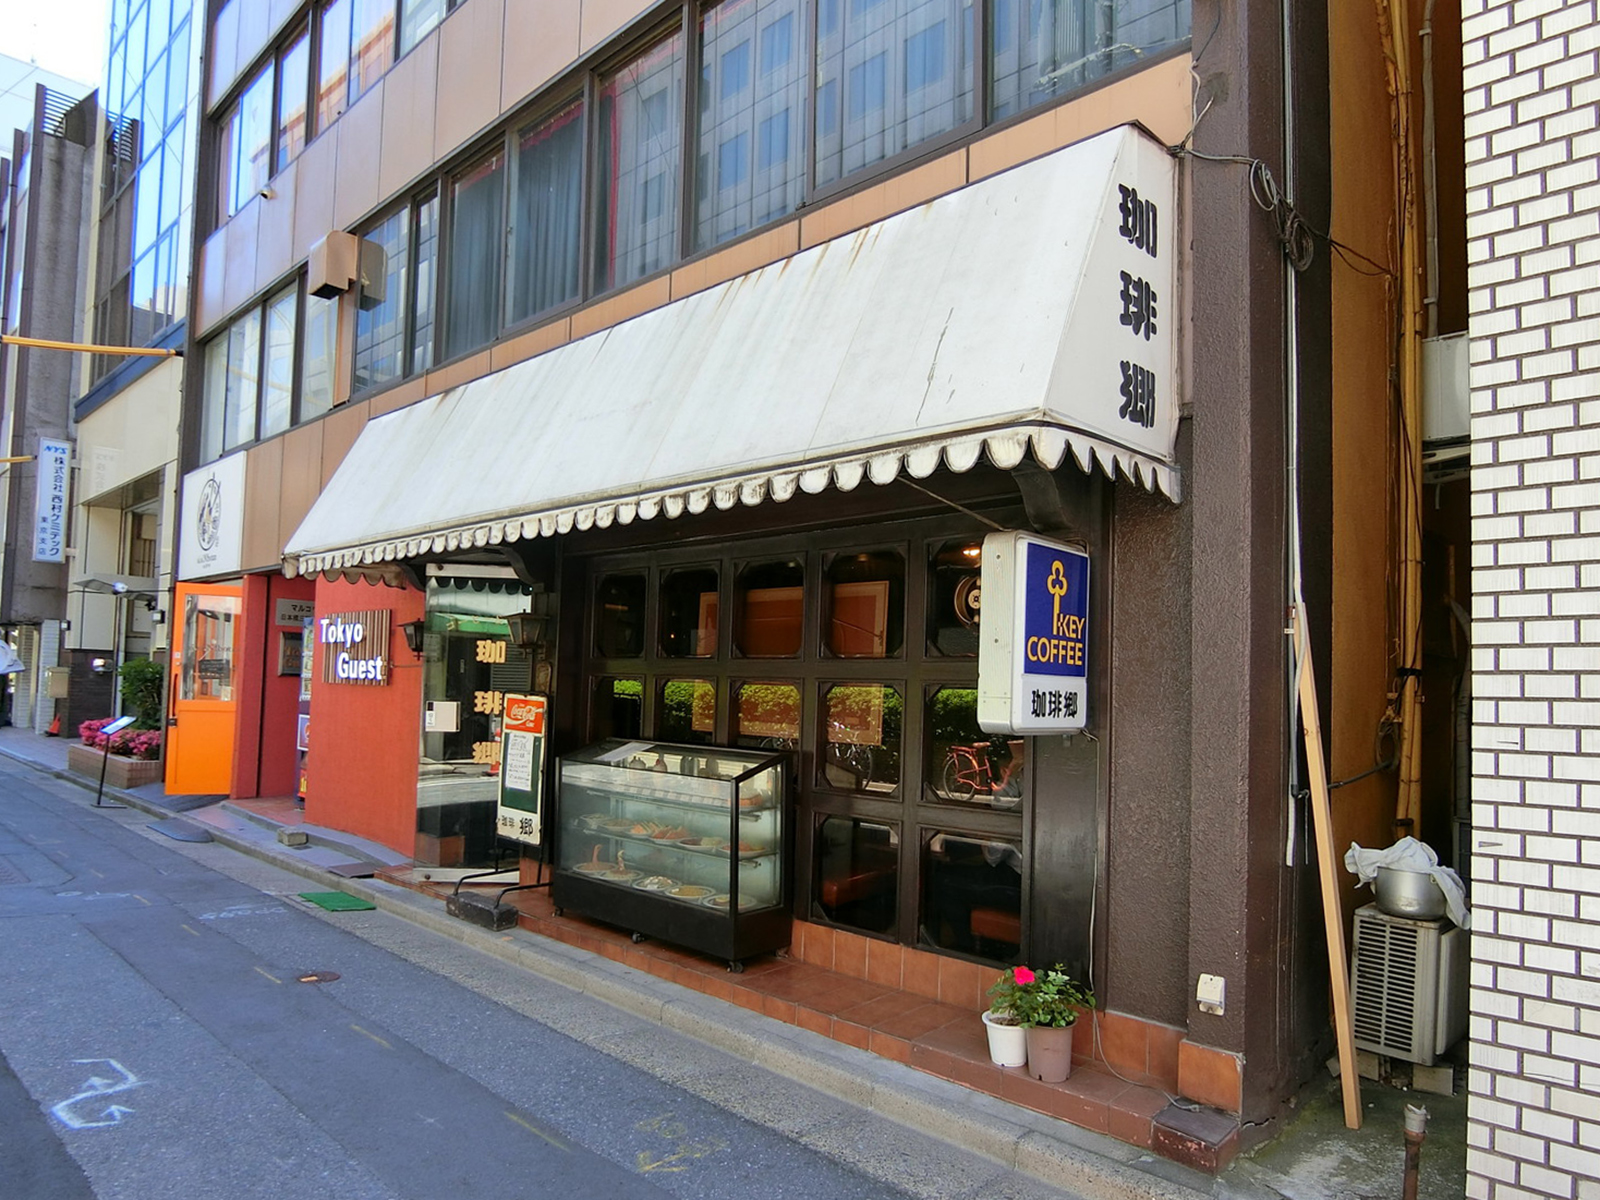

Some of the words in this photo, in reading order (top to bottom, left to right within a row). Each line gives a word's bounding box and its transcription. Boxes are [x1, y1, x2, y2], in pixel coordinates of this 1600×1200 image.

[43, 445, 68, 455] NYS
[291, 604, 315, 613] マルコ
[319, 617, 364, 649] Tokyo
[1056, 612, 1086, 639] KEY
[1026, 636, 1084, 666] COFFEE
[337, 651, 383, 681] Guest
